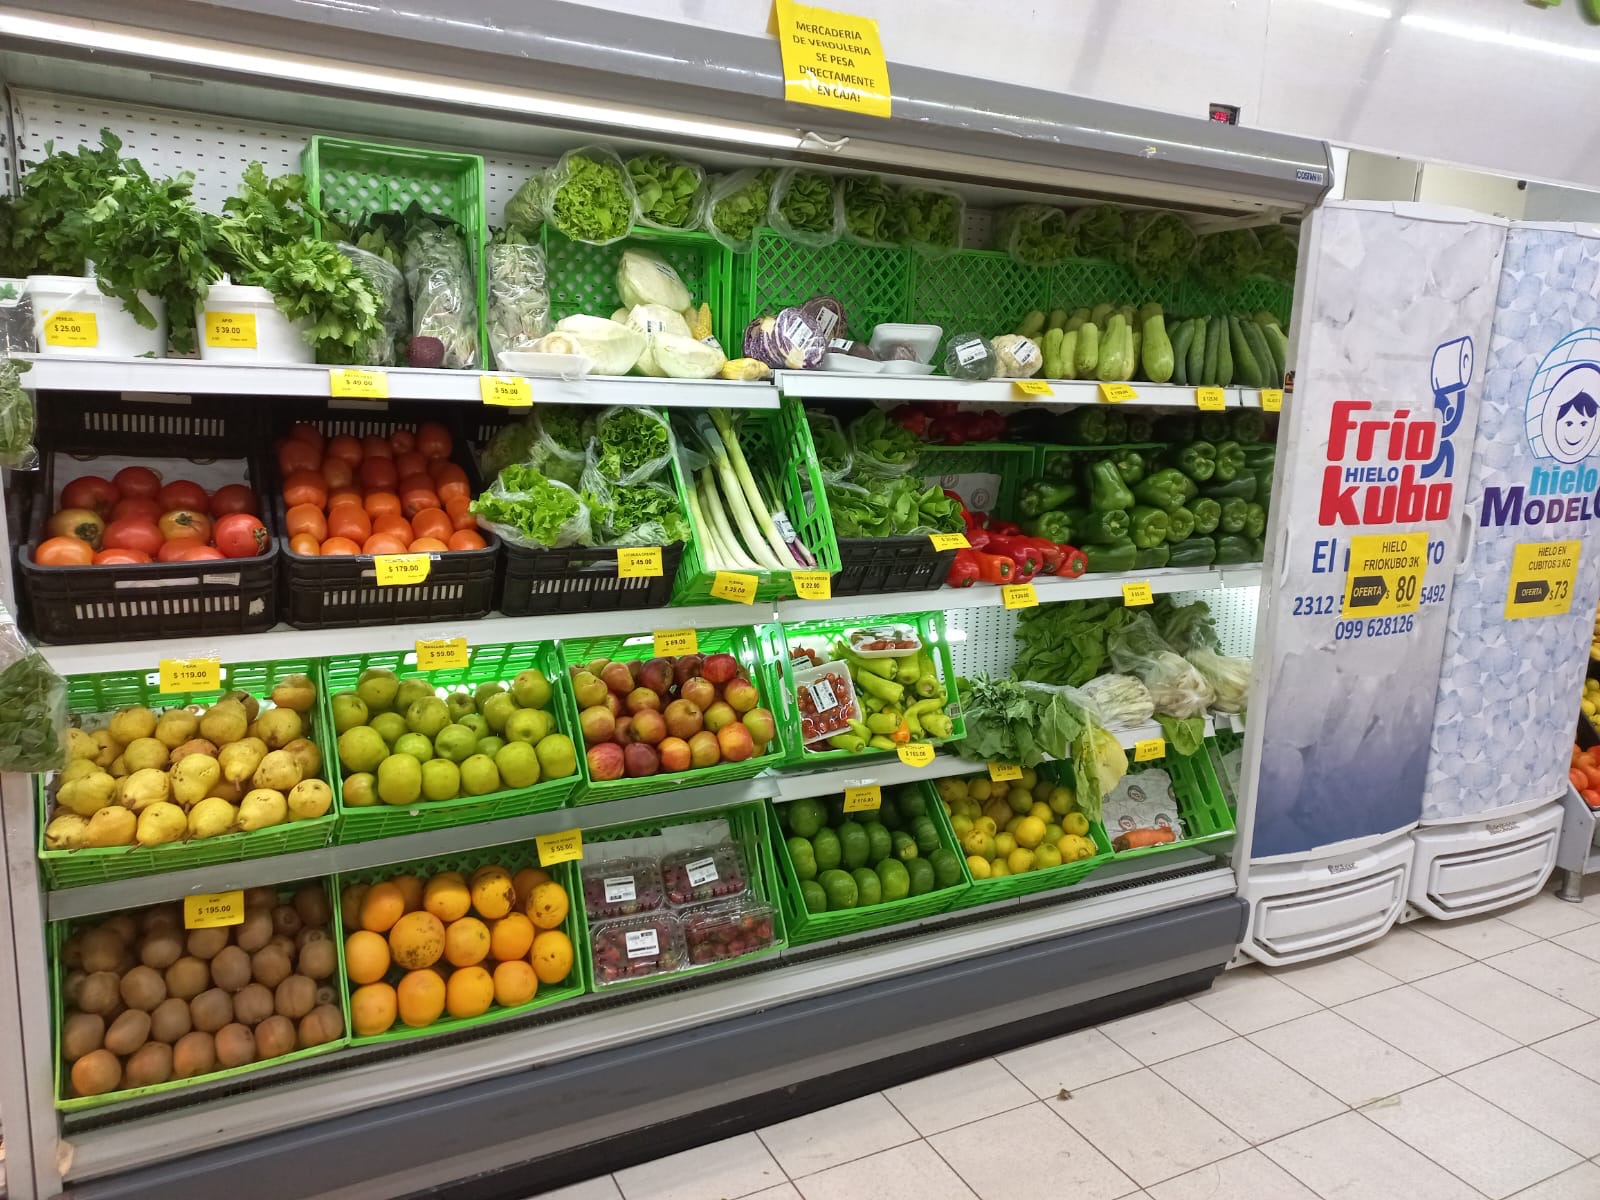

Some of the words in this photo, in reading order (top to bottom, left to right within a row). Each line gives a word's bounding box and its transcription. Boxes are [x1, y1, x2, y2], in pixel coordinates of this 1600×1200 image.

[796, 21, 862, 41] MERCADERIA
[792, 34, 806, 45] DE
[808, 37, 872, 56] VERDULERIA
[816, 52, 828, 63] SE
[830, 55, 855, 68] PESA
[799, 64, 875, 88] DIRECTAMENTE
[817, 85, 831, 97] EN
[833, 89, 861, 103] CAJA!
[61, 325, 81, 333] 25.00
[1345, 467, 1399, 482] HIELO
[1529, 464, 1598, 496] hielo
[1480, 485, 1600, 527] MODEL
[1382, 540, 1408, 553] HIELO
[1538, 546, 1558, 557] HIELO
[1558, 545, 1567, 555] EN
[1312, 538, 1337, 573] El
[1363, 556, 1408, 571] FRIOKUBO
[1408, 556, 1420, 568] 3K
[395, 564, 419, 572] 179.00
[1528, 559, 1557, 571] CUBITOS
[1561, 558, 1571, 568] KG
[1353, 586, 1382, 597] OFERTA
[1385, 590, 1390, 600] $
[1395, 574, 1417, 603] 80
[1521, 587, 1543, 597] OFERTA
[1292, 595, 1334, 616] 2312
[1419, 584, 1446, 605] 5492
[1335, 620, 1364, 640] 099
[1367, 614, 1414, 638] 628126
[205, 905, 231, 913] 195.00
